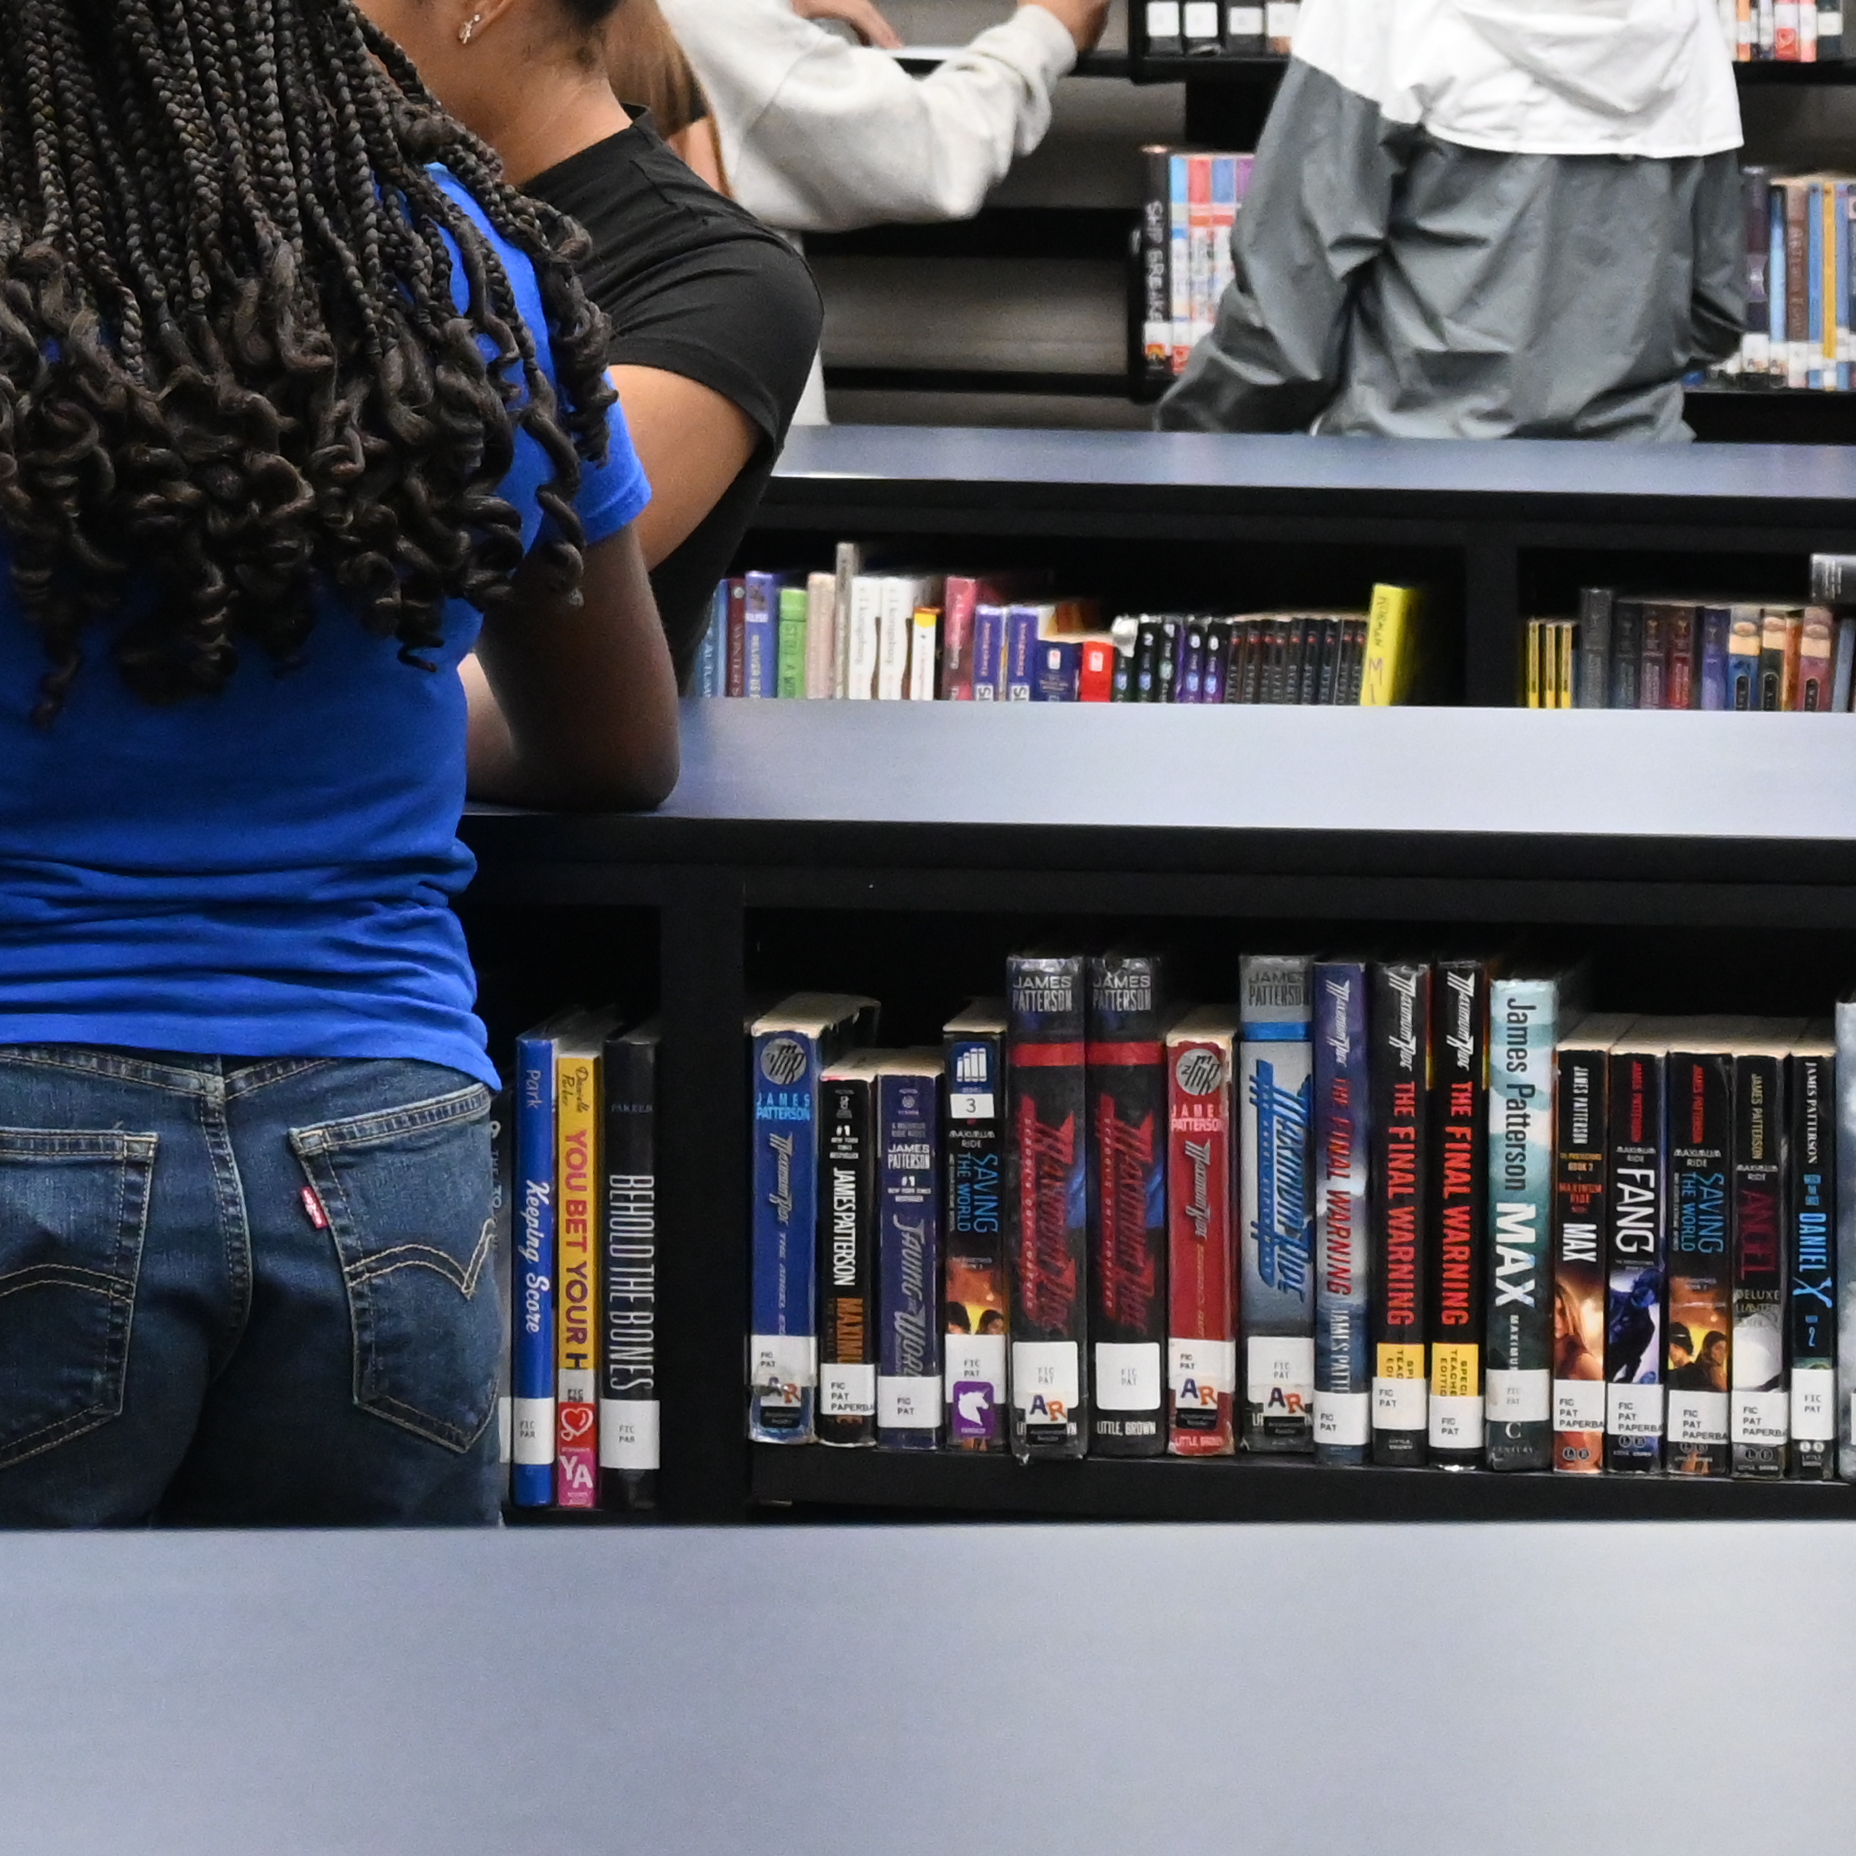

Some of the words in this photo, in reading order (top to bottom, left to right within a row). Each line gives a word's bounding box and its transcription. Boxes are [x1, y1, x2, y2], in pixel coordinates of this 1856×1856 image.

[1147, 249, 1164, 322] BREAKE
[1012, 989, 1072, 1012] PATTERSON
[1013, 976, 1072, 988] JAMES
[1092, 976, 1150, 988] JAMES
[1092, 989, 1152, 1011] PATTERSON
[1506, 997, 1537, 1073] James
[526, 1069, 539, 1110] Park
[756, 1093, 810, 1106] JAMES
[756, 1107, 811, 1121] PATTERSON
[966, 1098, 976, 1113] 3
[1394, 1081, 1416, 1117] THE
[1450, 1081, 1474, 1116] THE
[565, 1129, 588, 1192] YOU
[888, 1144, 929, 1153] JAMES
[888, 1154, 930, 1169] PATTERSON
[1326, 1116, 1351, 1181] FINAL
[1504, 1083, 1536, 1191] Patterson
[957, 1153, 971, 1177] THE
[1388, 1127, 1416, 1199] FINAL
[1444, 1127, 1472, 1199] FINAL
[1681, 1172, 1696, 1198] THE
[609, 1175, 654, 1258] BEHOLD
[957, 1183, 971, 1232] WORLD
[973, 1153, 998, 1232] SAVING
[1615, 1168, 1655, 1253] FANG
[1698, 1172, 1724, 1254] SAVING
[518, 1180, 550, 1263] Keeping
[566, 1199, 587, 1254] BET
[1326, 1190, 1351, 1295] WARNING
[1562, 1223, 1597, 1262] MAX
[1681, 1202, 1696, 1252] WORLD
[1387, 1206, 1416, 1326] WARNING
[1442, 1206, 1471, 1326] WARNING
[1495, 1202, 1536, 1308] MAX
[526, 1272, 550, 1333] Score
[565, 1259, 588, 1344] YOUR
[609, 1264, 654, 1303] THE
[609, 1311, 654, 1391] BONES
[1560, 1398, 1574, 1406] FIC
[619, 1425, 634, 1433] FIC
[619, 1435, 635, 1443] PAR
[1097, 1421, 1123, 1436] LITTLE,
[1125, 1421, 1156, 1435] BROWN
[560, 1455, 593, 1489] YA
